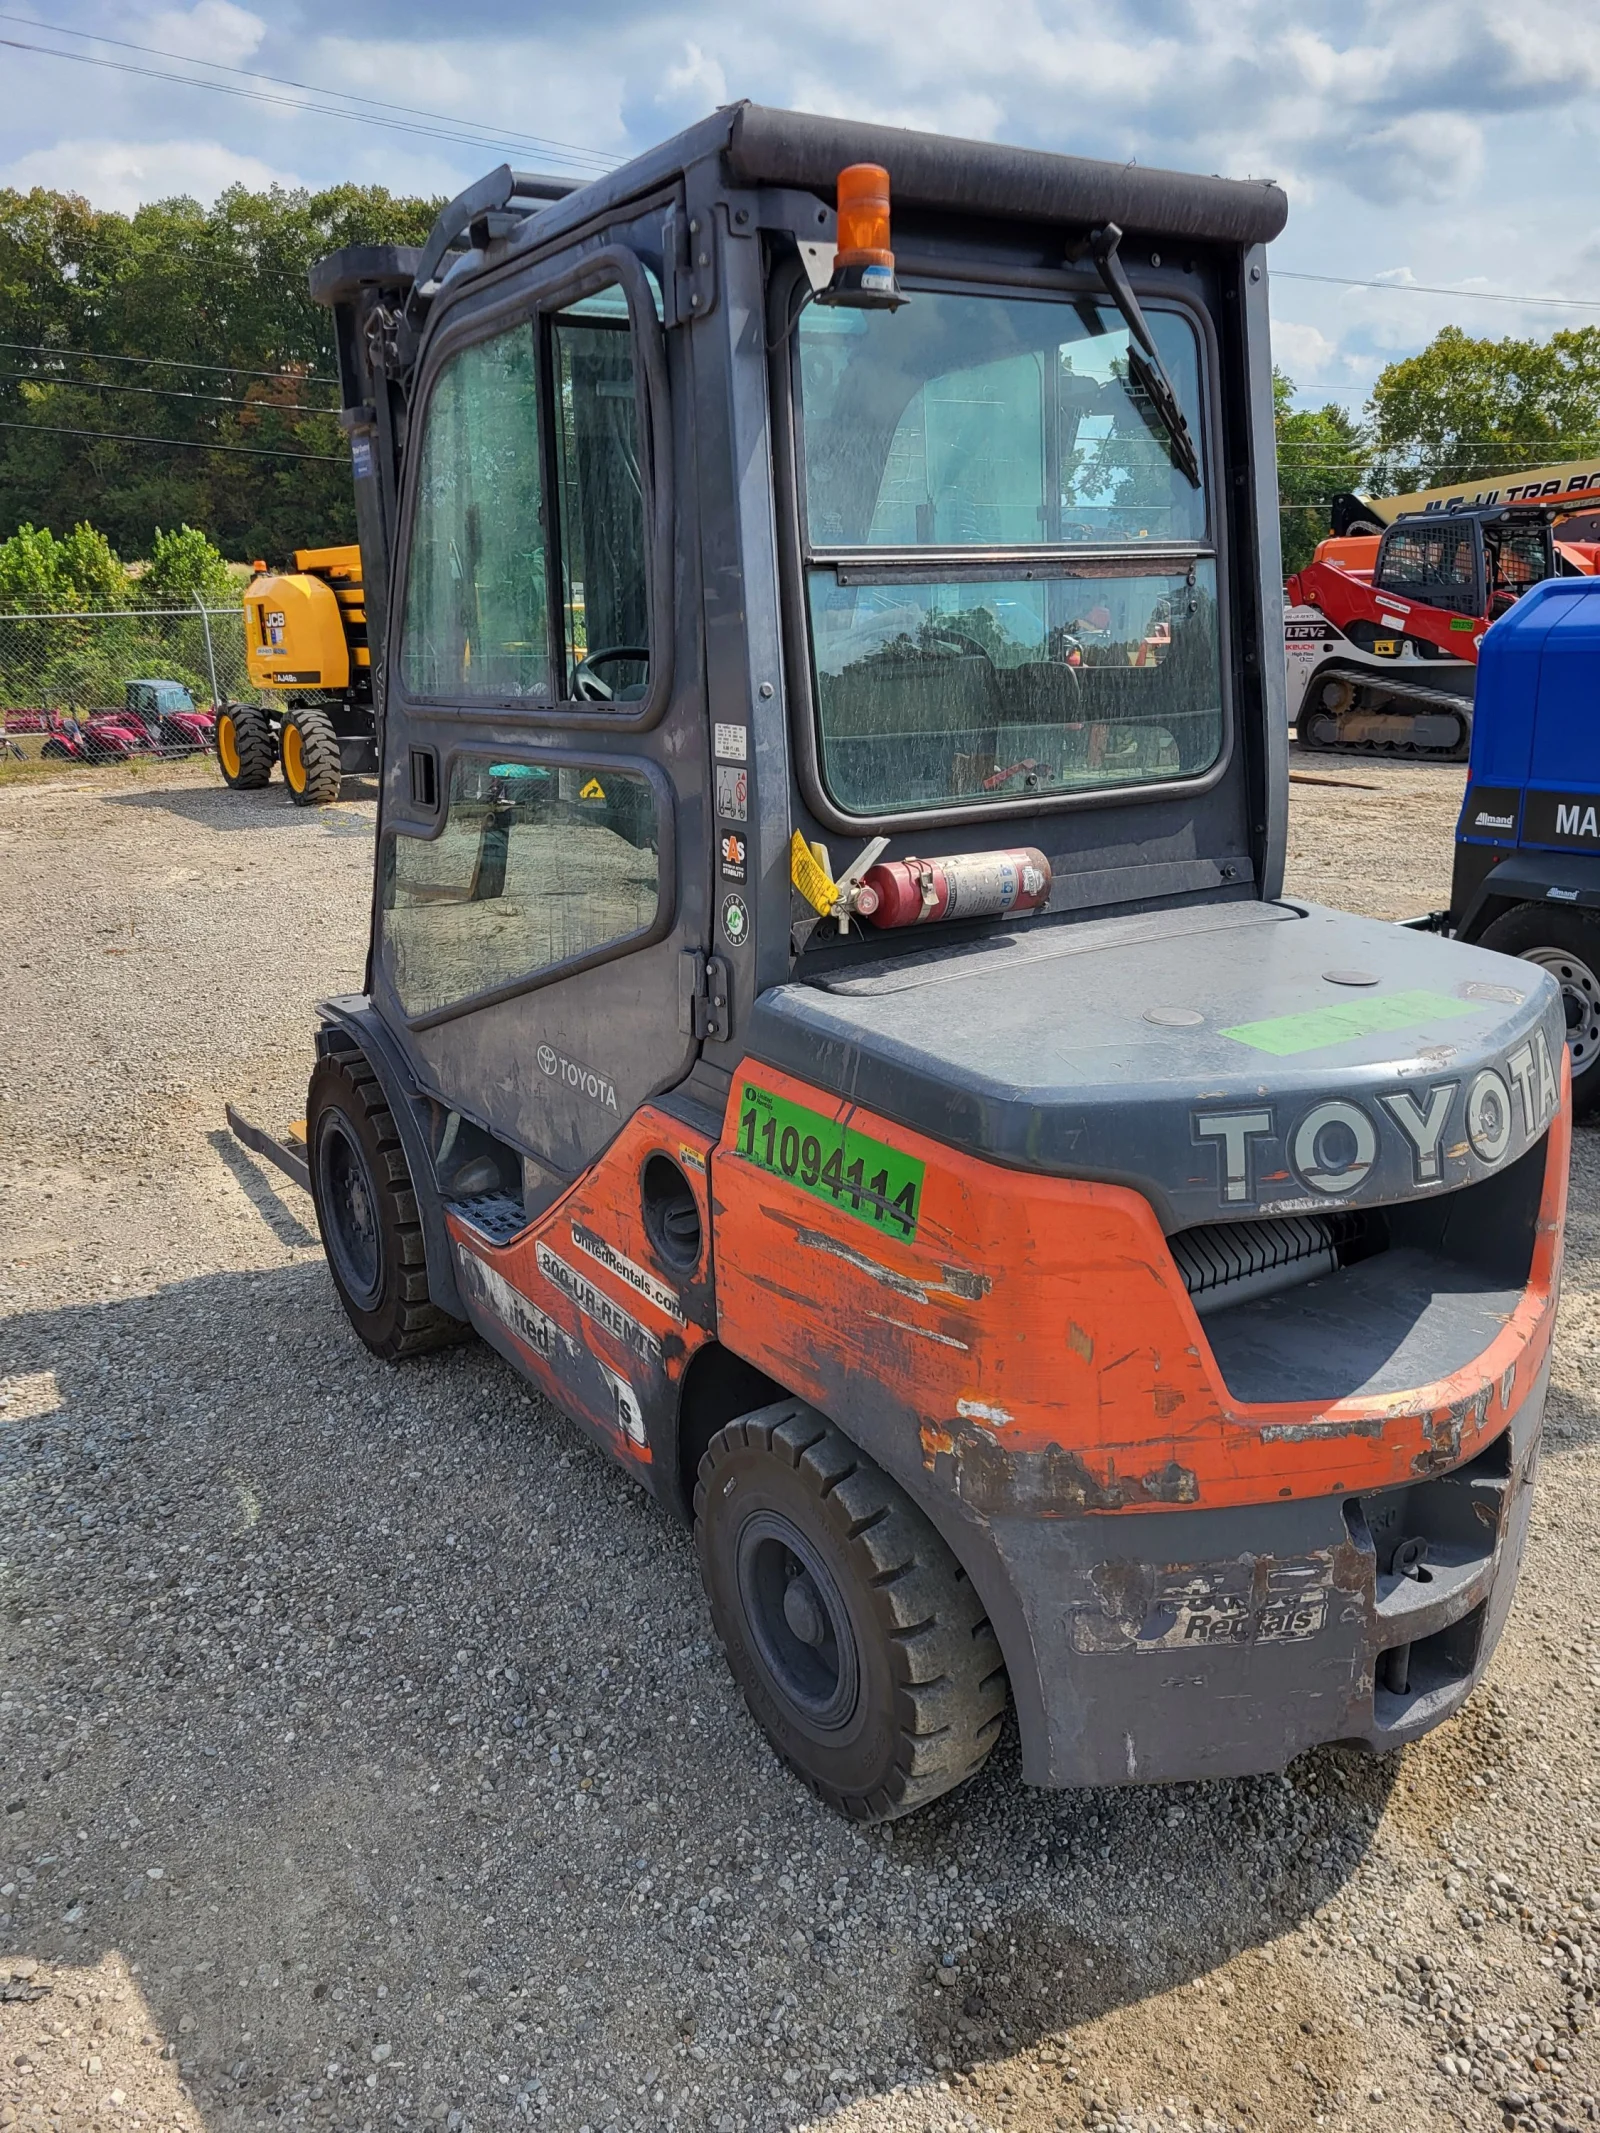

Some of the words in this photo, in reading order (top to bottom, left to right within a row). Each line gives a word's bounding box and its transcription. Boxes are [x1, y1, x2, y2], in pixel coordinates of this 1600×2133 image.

[266, 612, 285, 627] JCB
[1475, 812, 1514, 828] Allmand
[1555, 804, 1600, 838] MA
[721, 835, 745, 863] SAS
[723, 867, 745, 878] STABILITY
[725, 896, 740, 907] TIER
[1546, 887, 1579, 900] Allmand
[726, 930, 745, 943] FINAL
[559, 1057, 617, 1111] TOYOTA
[1195, 1027, 1561, 1203] TOYOTA
[742, 1108, 917, 1236] 11094114
